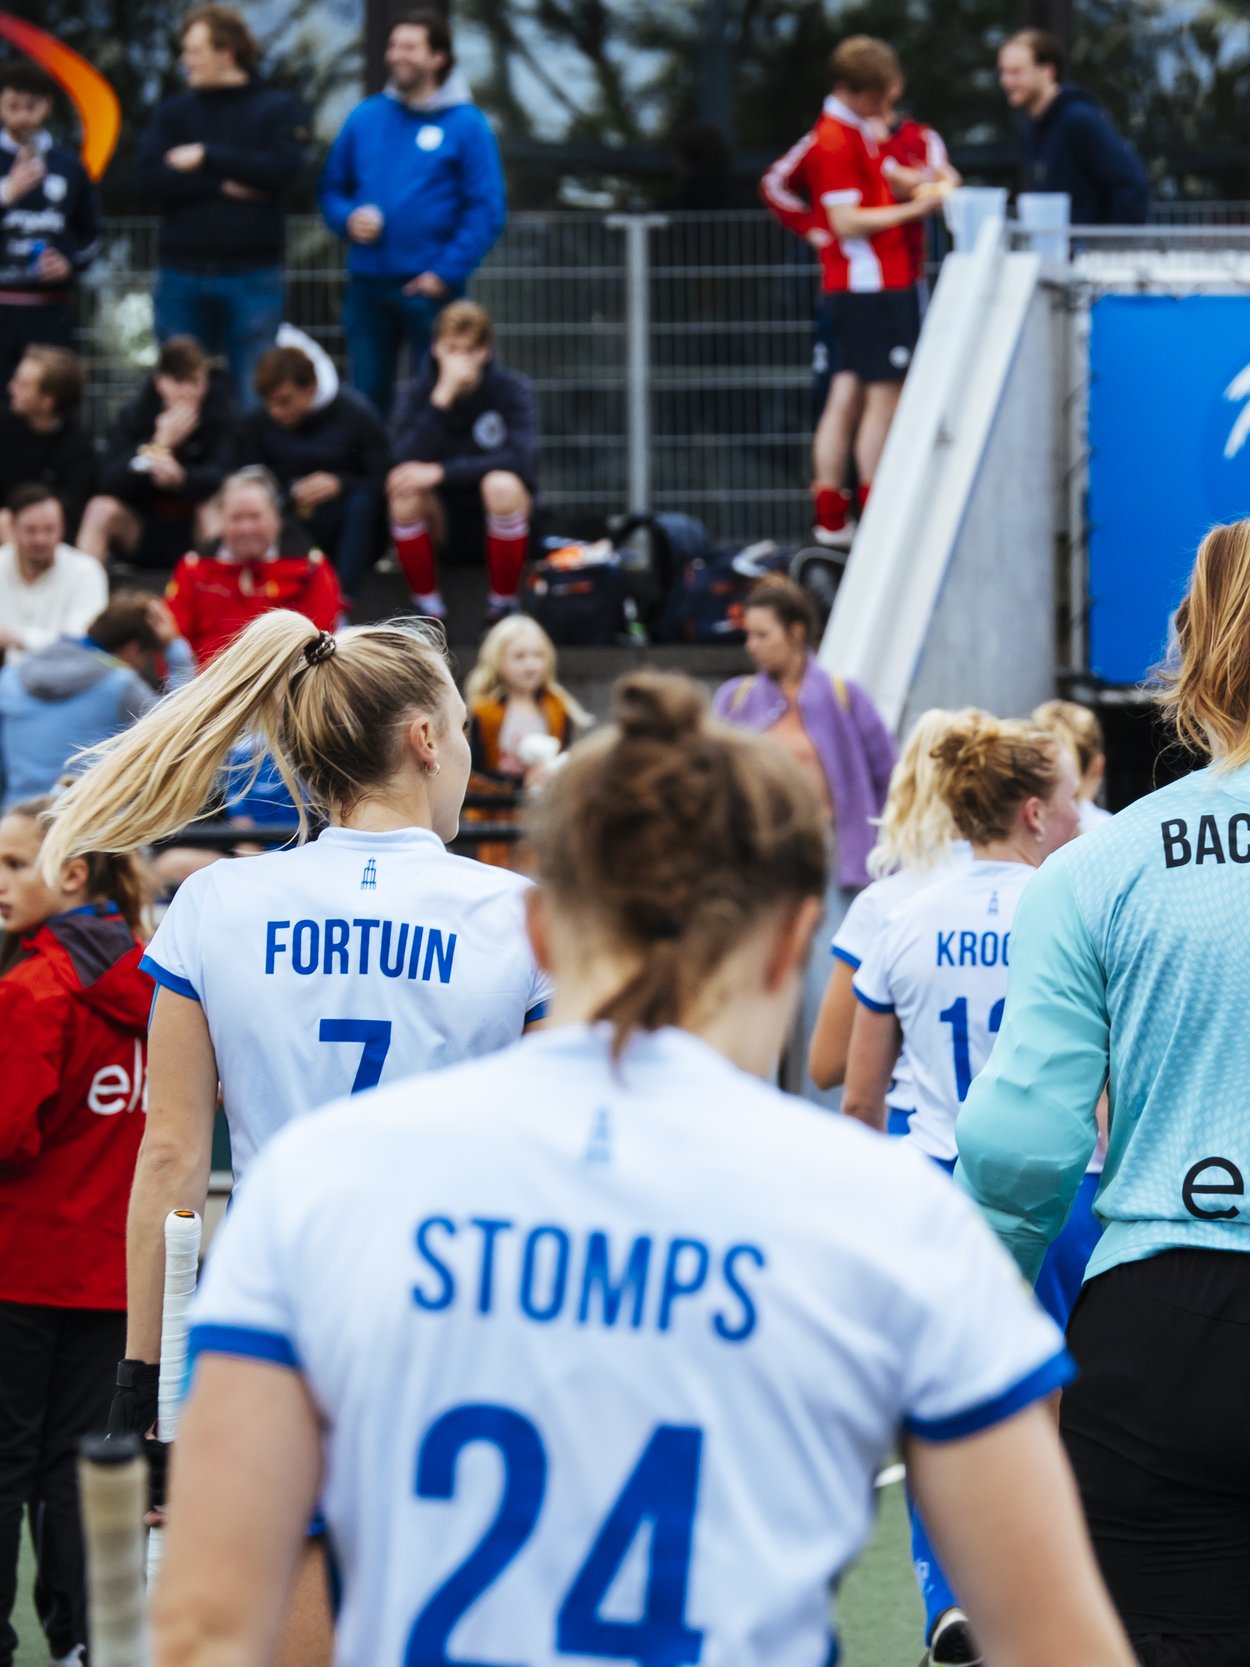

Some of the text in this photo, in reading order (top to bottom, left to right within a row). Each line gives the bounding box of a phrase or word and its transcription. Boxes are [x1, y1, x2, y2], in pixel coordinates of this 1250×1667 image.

[265, 918, 457, 984] FORTUIN
[318, 1018, 392, 1097] 7
[412, 1215, 766, 1343] STOMPS
[403, 1401, 706, 1667] 24
